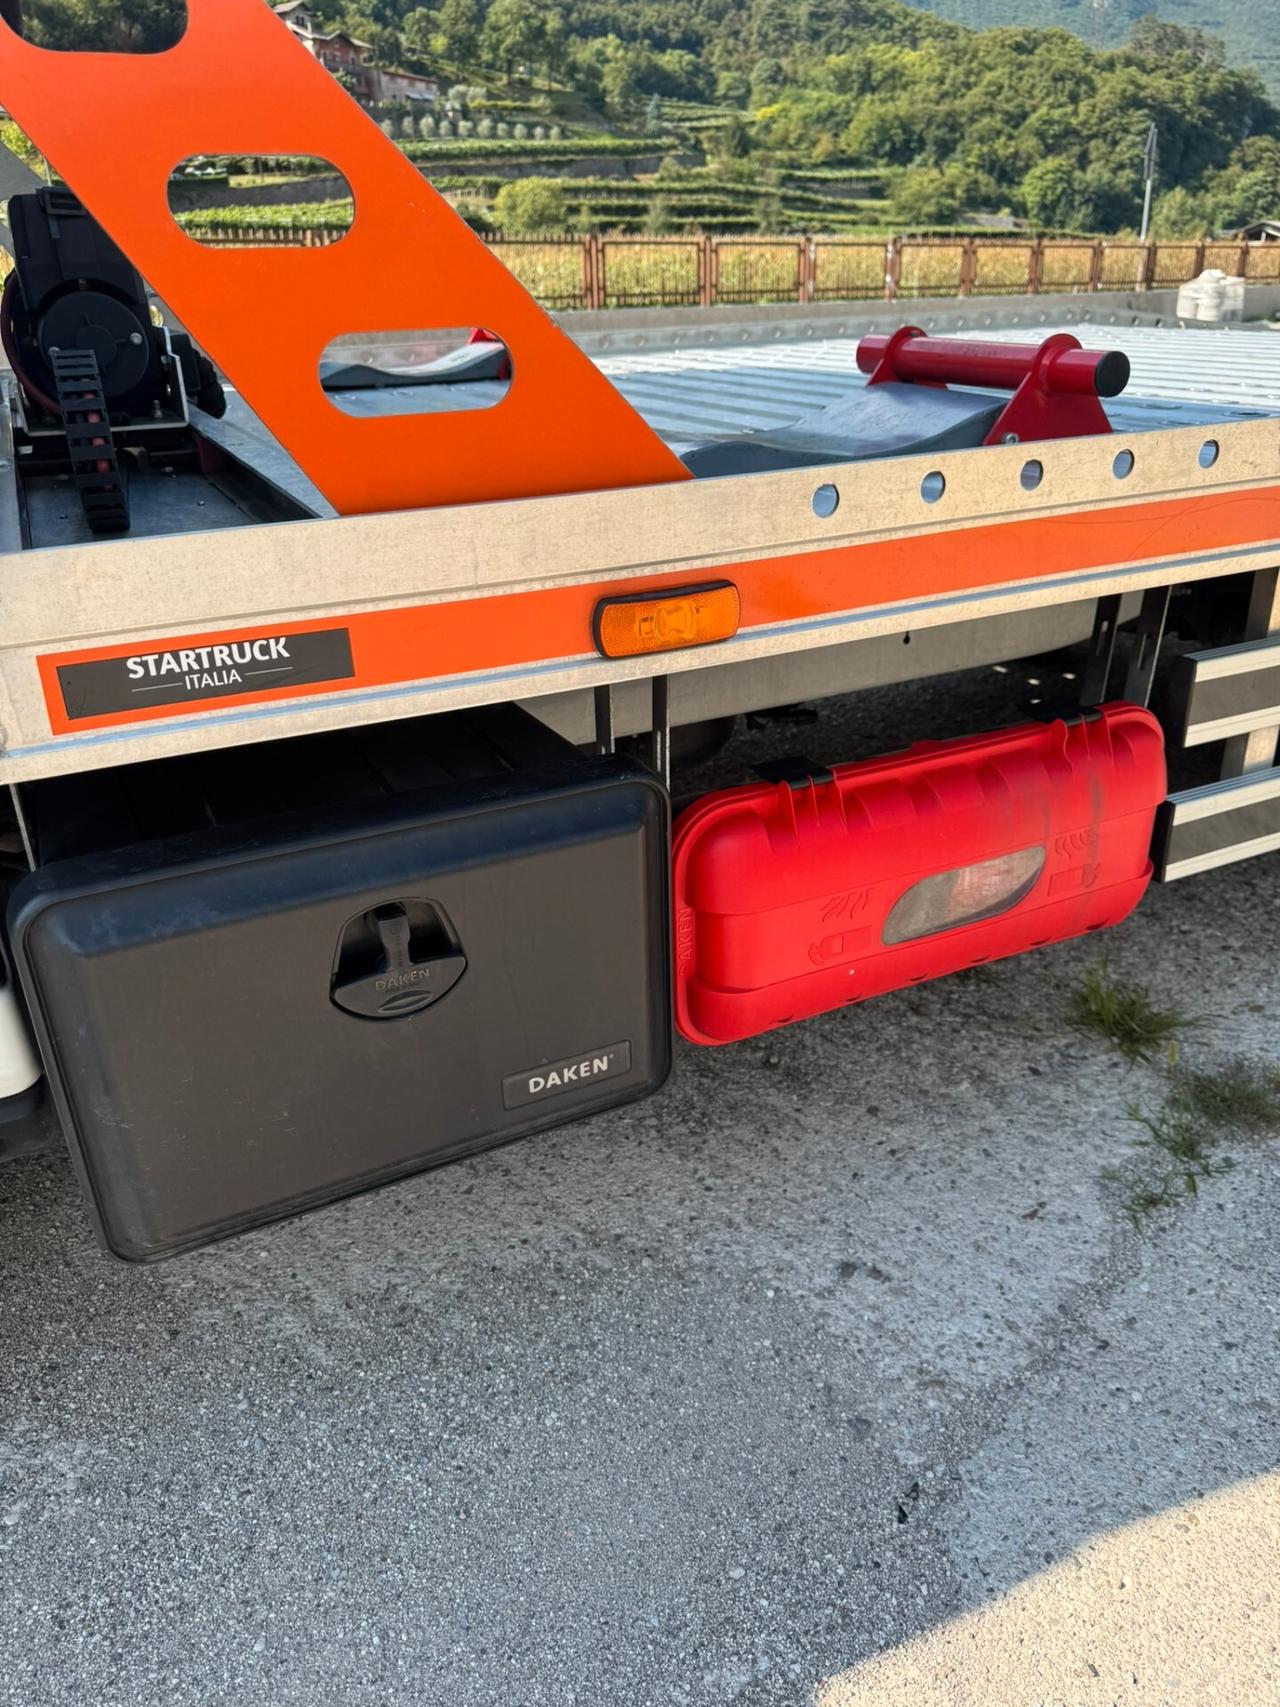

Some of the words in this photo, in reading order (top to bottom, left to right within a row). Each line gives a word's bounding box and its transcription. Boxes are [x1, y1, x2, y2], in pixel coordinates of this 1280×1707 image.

[126, 637, 290, 679] STARTRUCK
[185, 669, 242, 690] ITALIA
[679, 907, 693, 976] DAKEN
[375, 968, 431, 991] DAKEN
